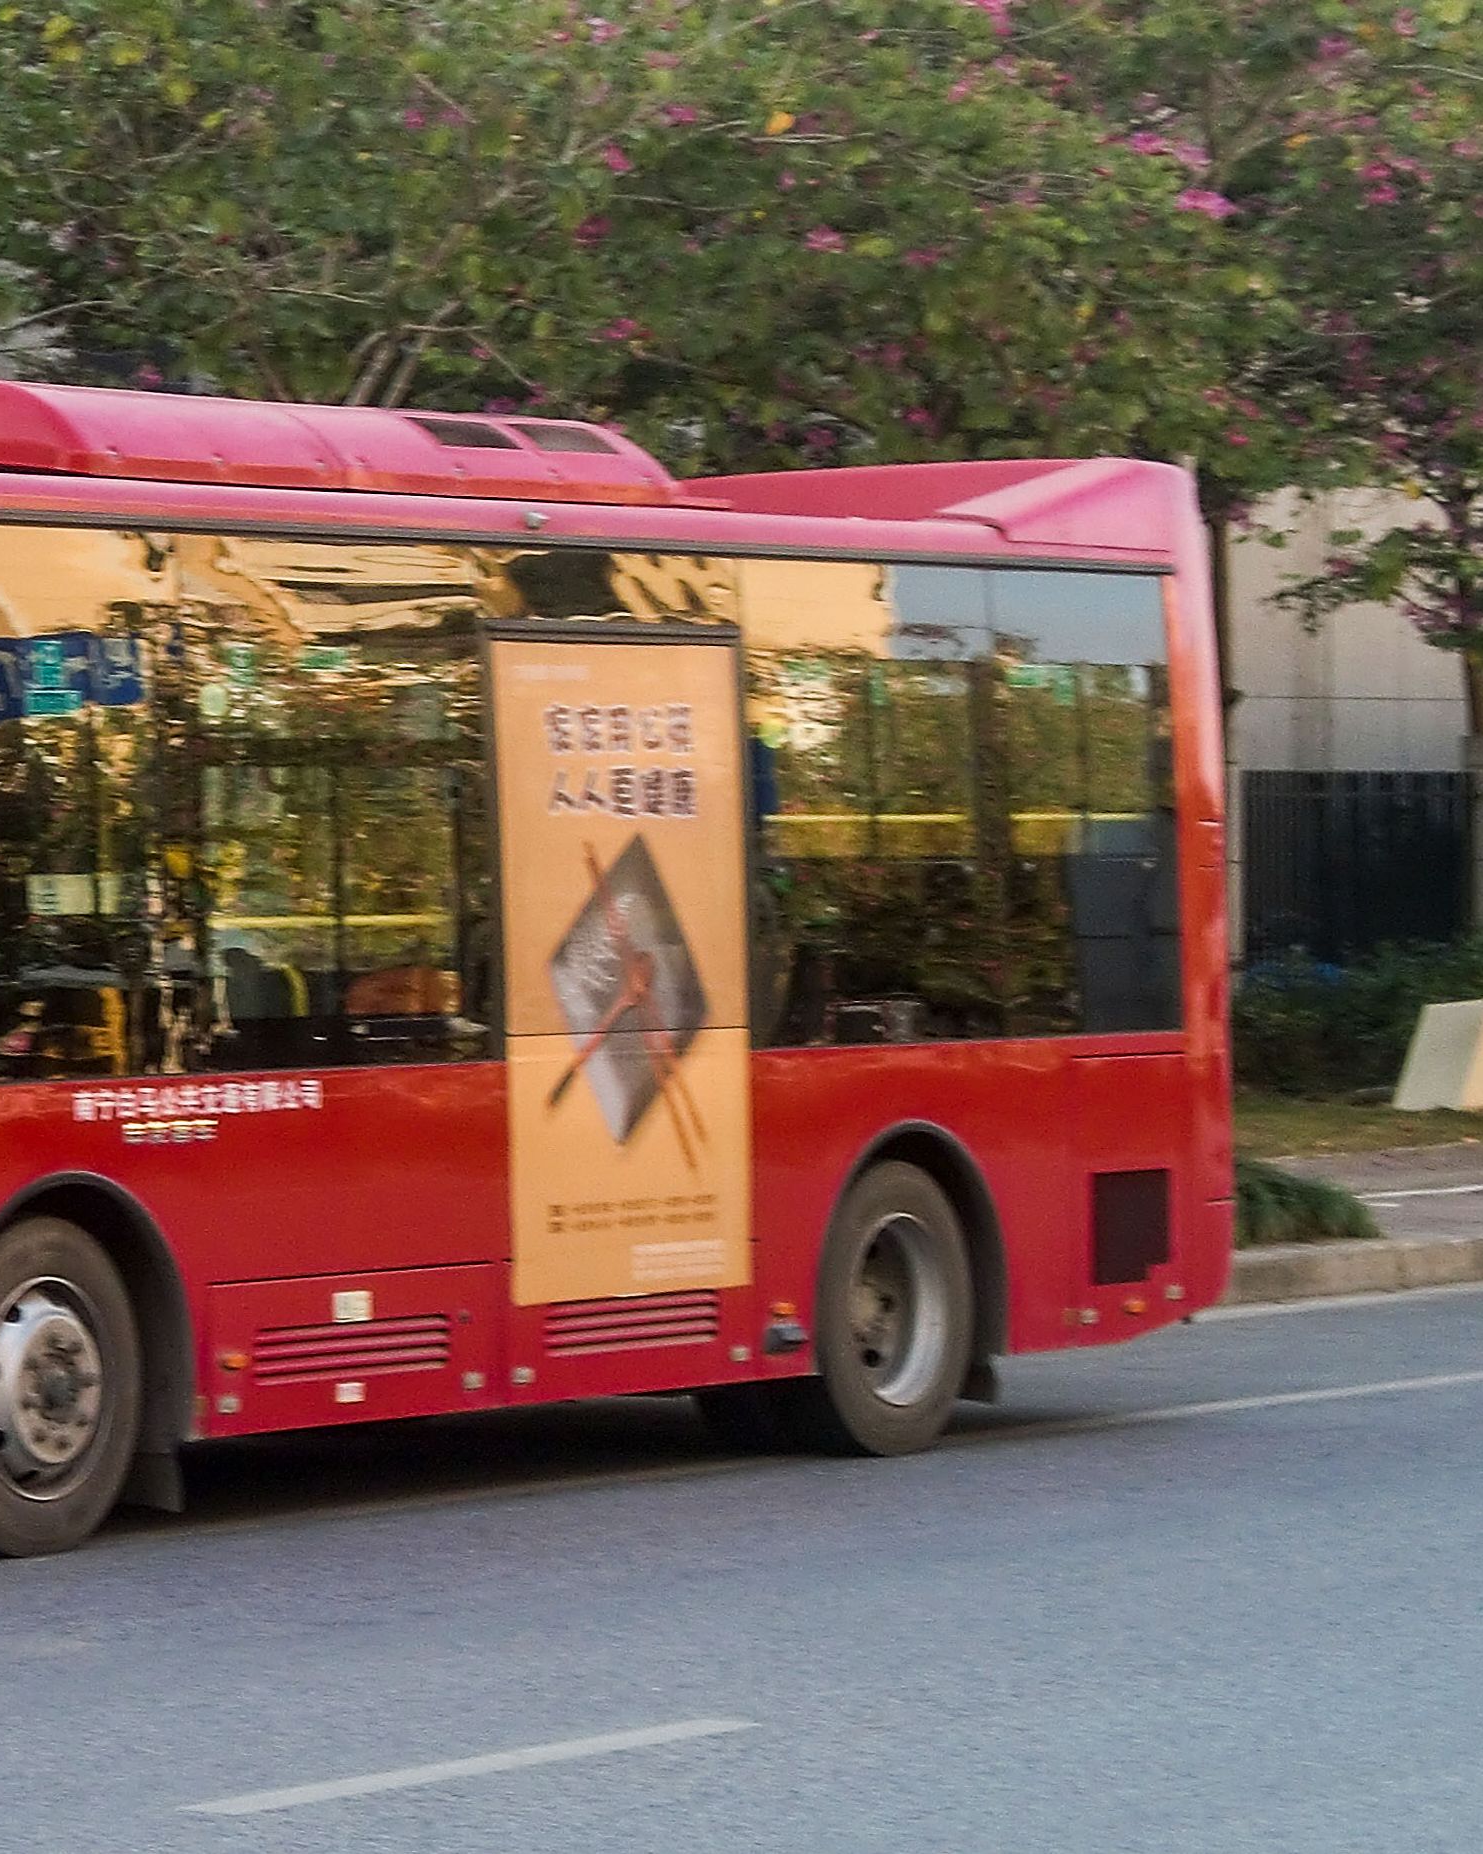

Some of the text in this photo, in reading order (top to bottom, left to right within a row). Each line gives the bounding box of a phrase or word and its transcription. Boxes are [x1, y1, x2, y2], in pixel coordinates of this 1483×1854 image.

[547, 765, 698, 819] 人人更健康
